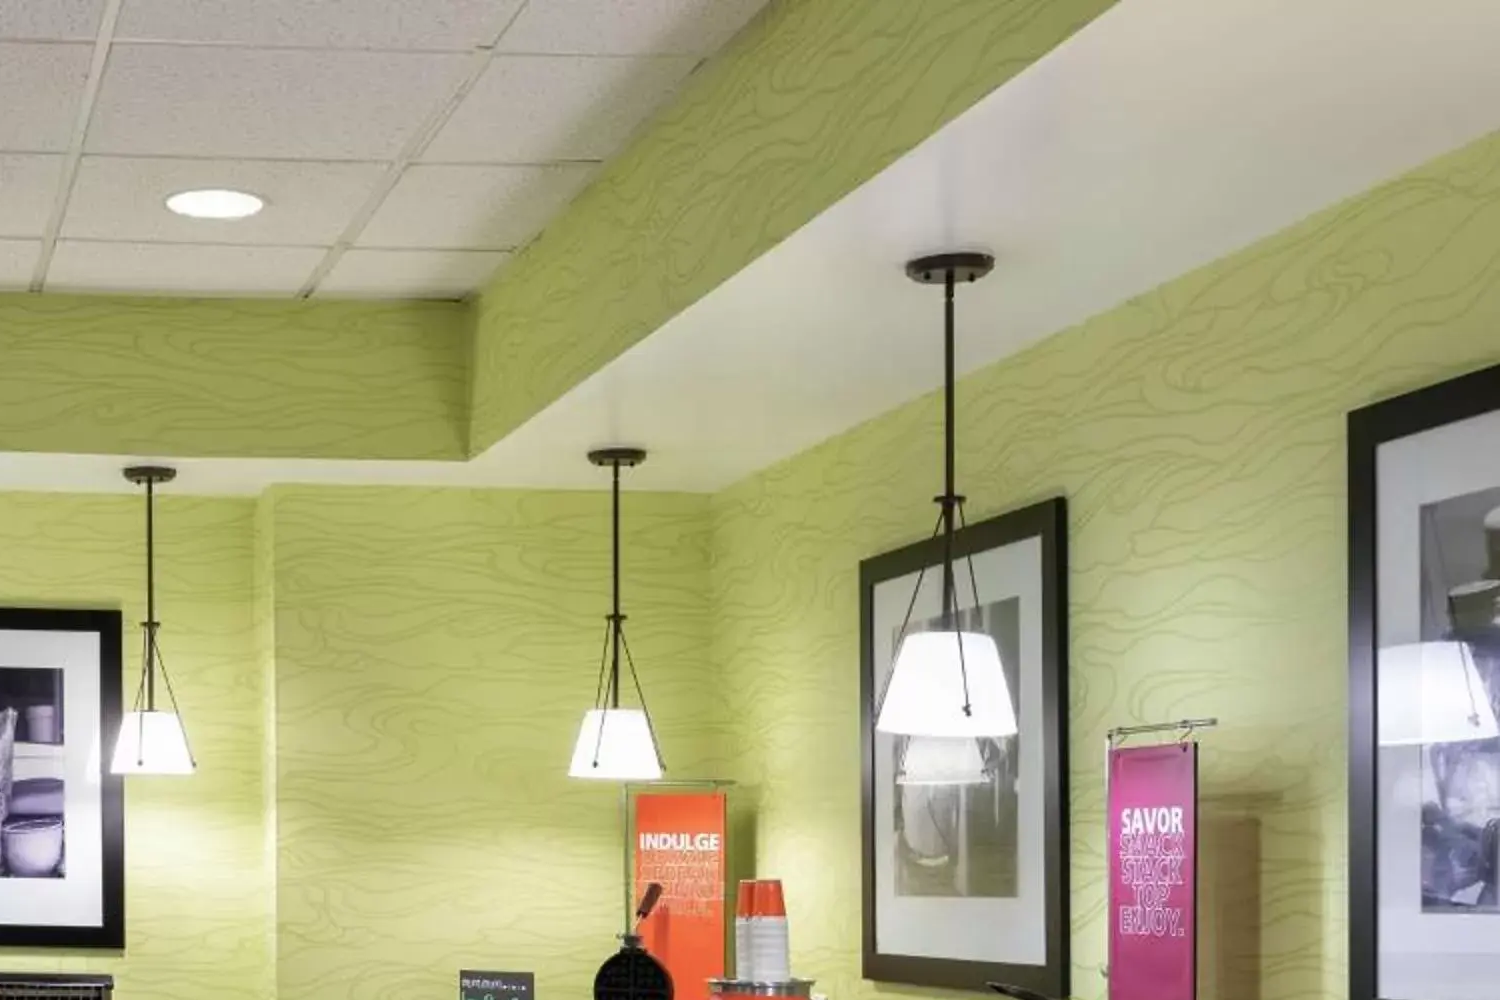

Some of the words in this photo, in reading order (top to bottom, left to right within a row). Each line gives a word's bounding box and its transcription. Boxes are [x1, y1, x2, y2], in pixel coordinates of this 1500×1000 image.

[1121, 806, 1184, 834] SAVOR
[639, 832, 720, 851] INDULGE
[1121, 857, 1185, 884] STACK
[1132, 882, 1170, 907] TOP
[1119, 905, 1186, 936] ENJOY.
